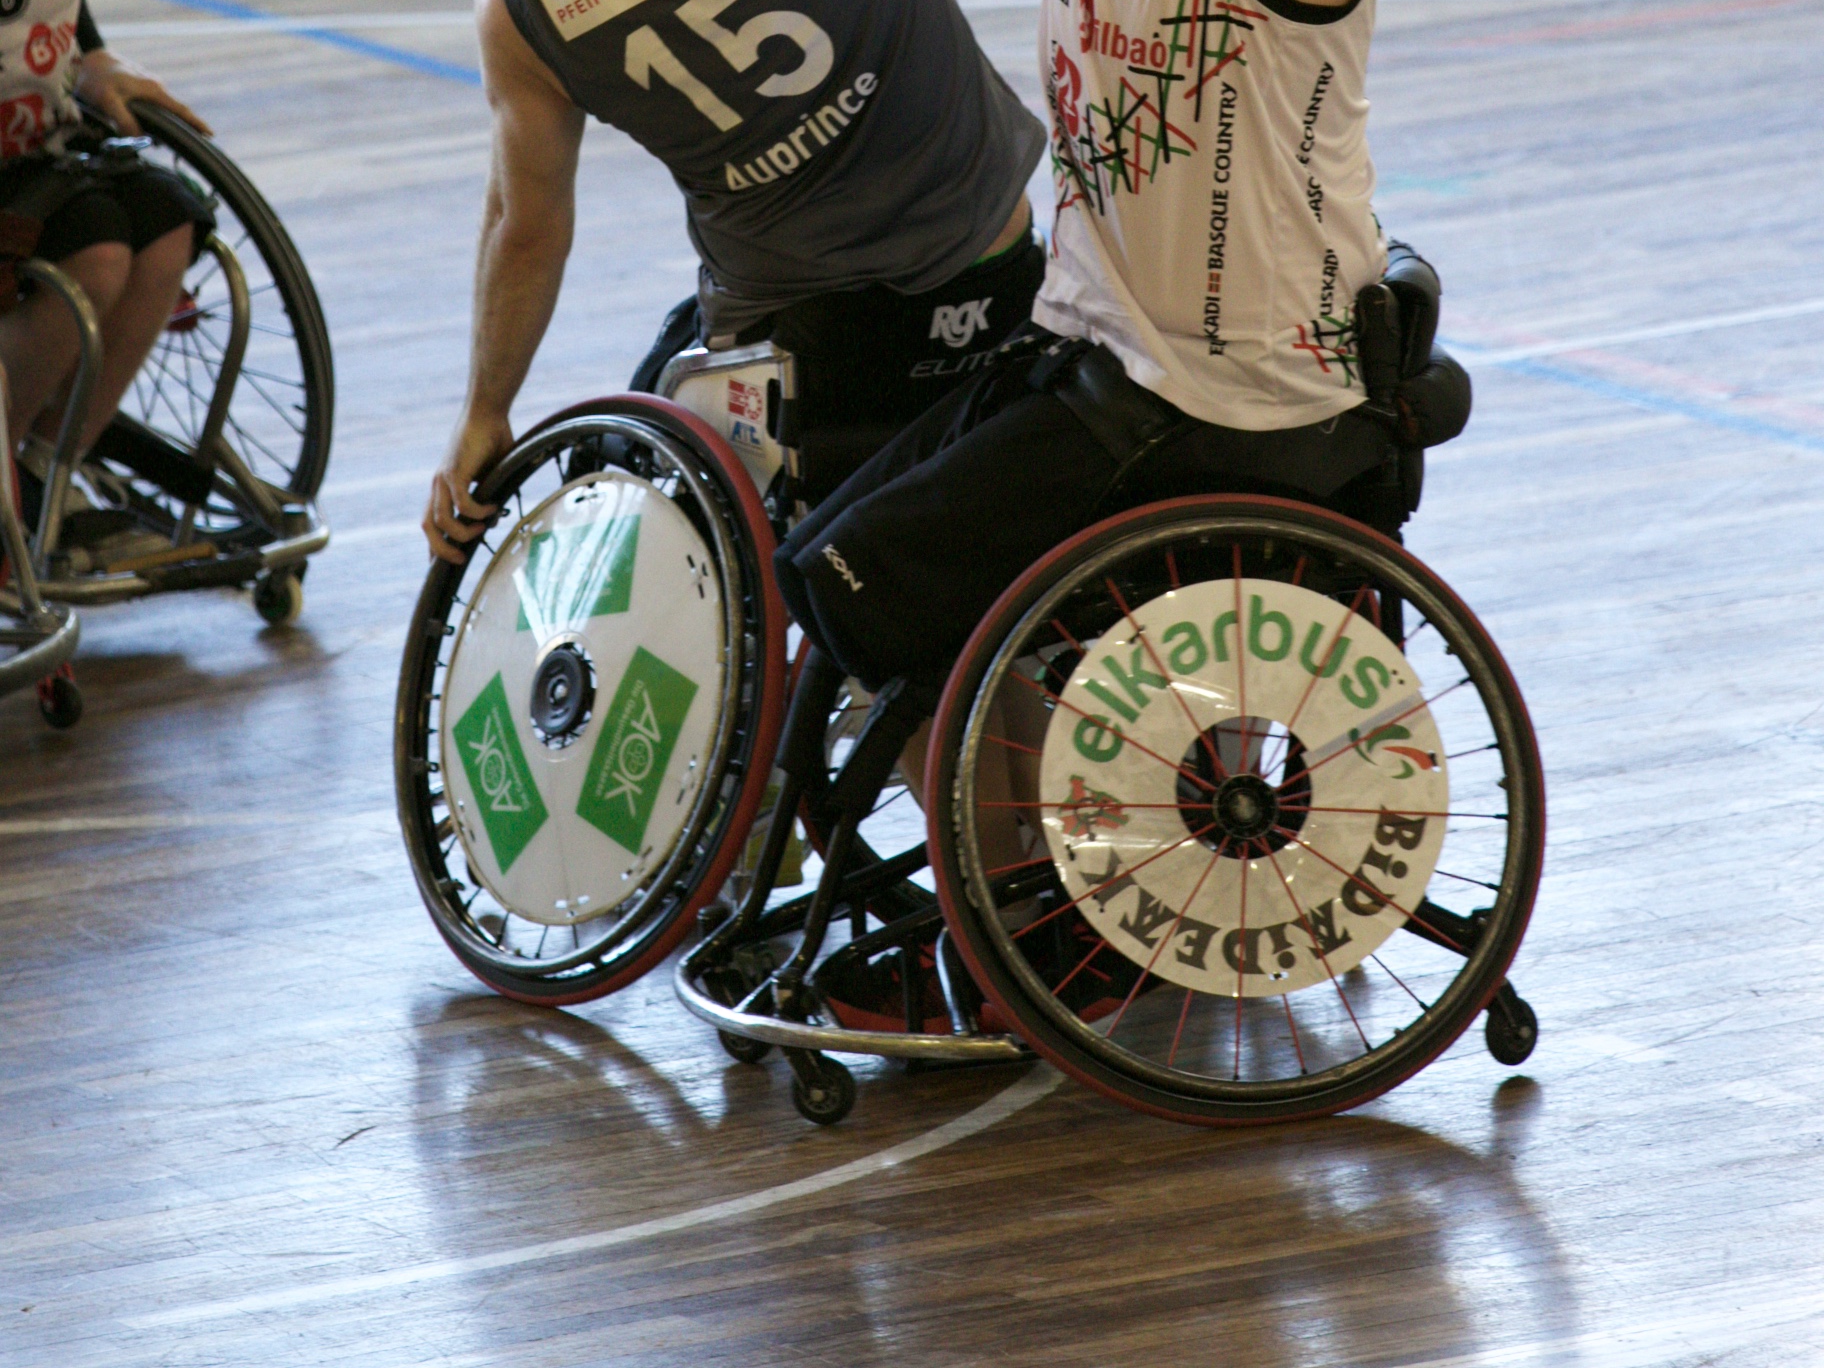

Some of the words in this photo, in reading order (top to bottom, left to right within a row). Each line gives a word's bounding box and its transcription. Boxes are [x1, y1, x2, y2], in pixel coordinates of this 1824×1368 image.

[1213, 81, 1238, 183] COUNTRY
[1300, 61, 1335, 152] COUNTRY
[1207, 188, 1229, 270] BASQUE
[928, 296, 993, 348] RGK
[1072, 594, 1391, 763] elkarbus
[469, 715, 522, 812] AOK
[604, 688, 661, 818] AOK
